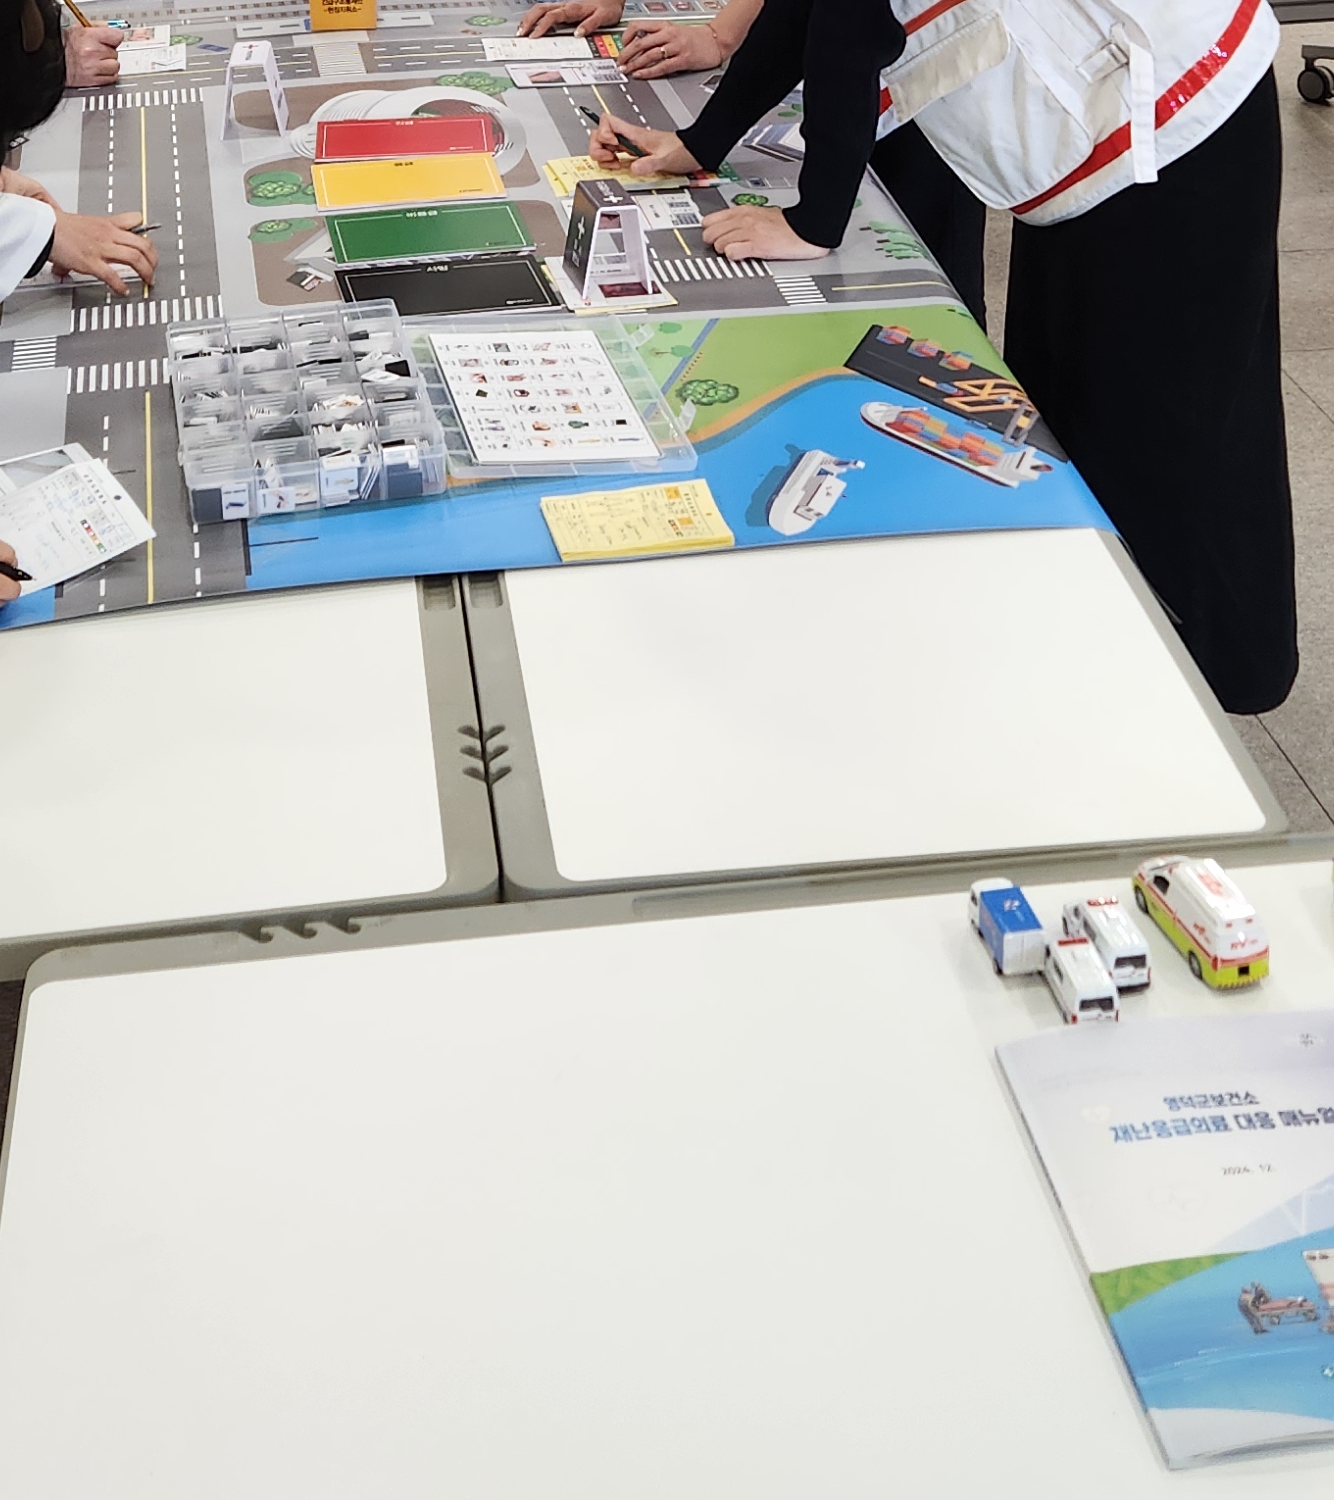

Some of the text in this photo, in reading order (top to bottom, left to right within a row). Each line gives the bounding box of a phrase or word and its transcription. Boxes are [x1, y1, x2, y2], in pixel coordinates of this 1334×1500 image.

[1163, 1090, 1261, 1112] 영덕군보건소
[1109, 1113, 1233, 1143] 재난응급의료
[1233, 1110, 1276, 1131] 대응
